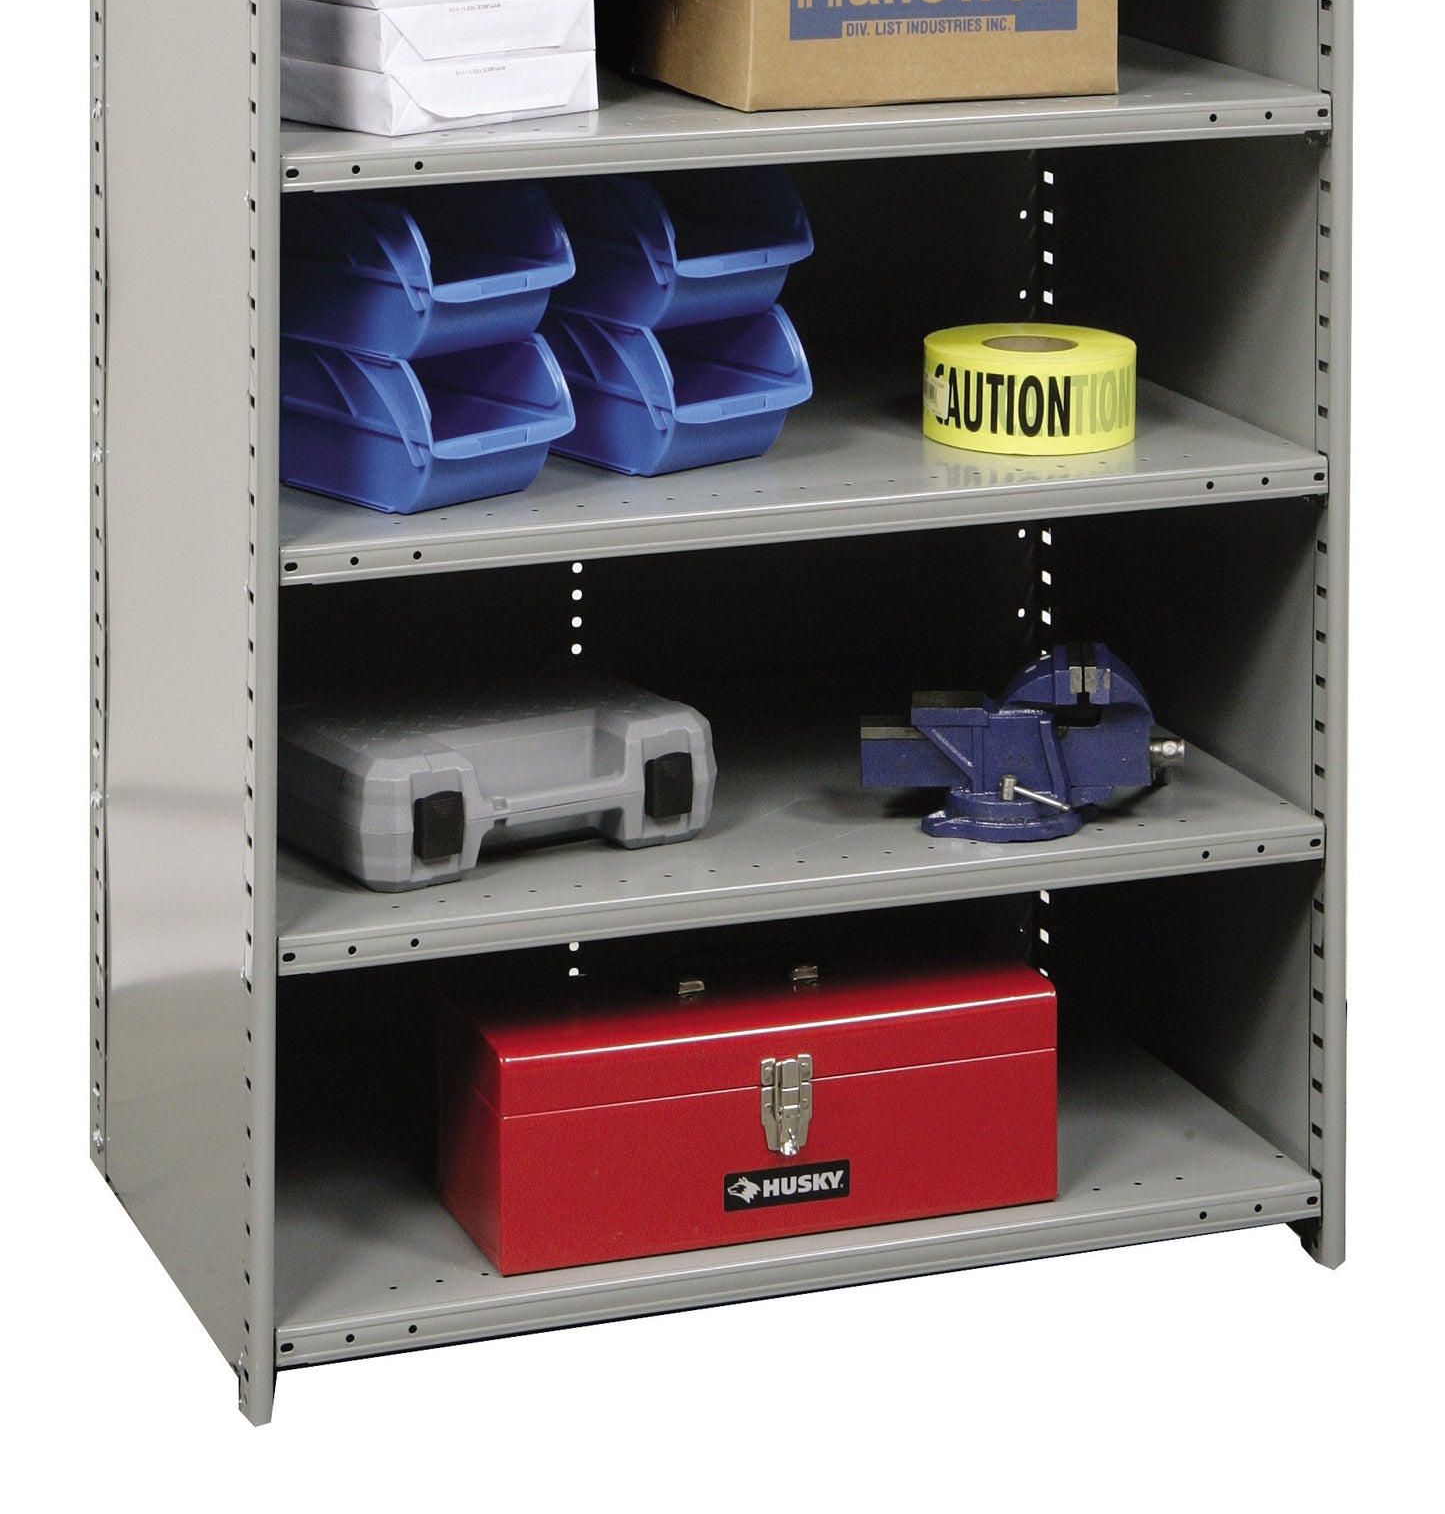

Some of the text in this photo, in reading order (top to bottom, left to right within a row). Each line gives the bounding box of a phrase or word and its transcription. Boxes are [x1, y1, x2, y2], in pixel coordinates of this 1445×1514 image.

[846, 17, 1011, 37] DIV. LIST INDUSTRIES INC.
[762, 1170, 844, 1198] HUSKY
